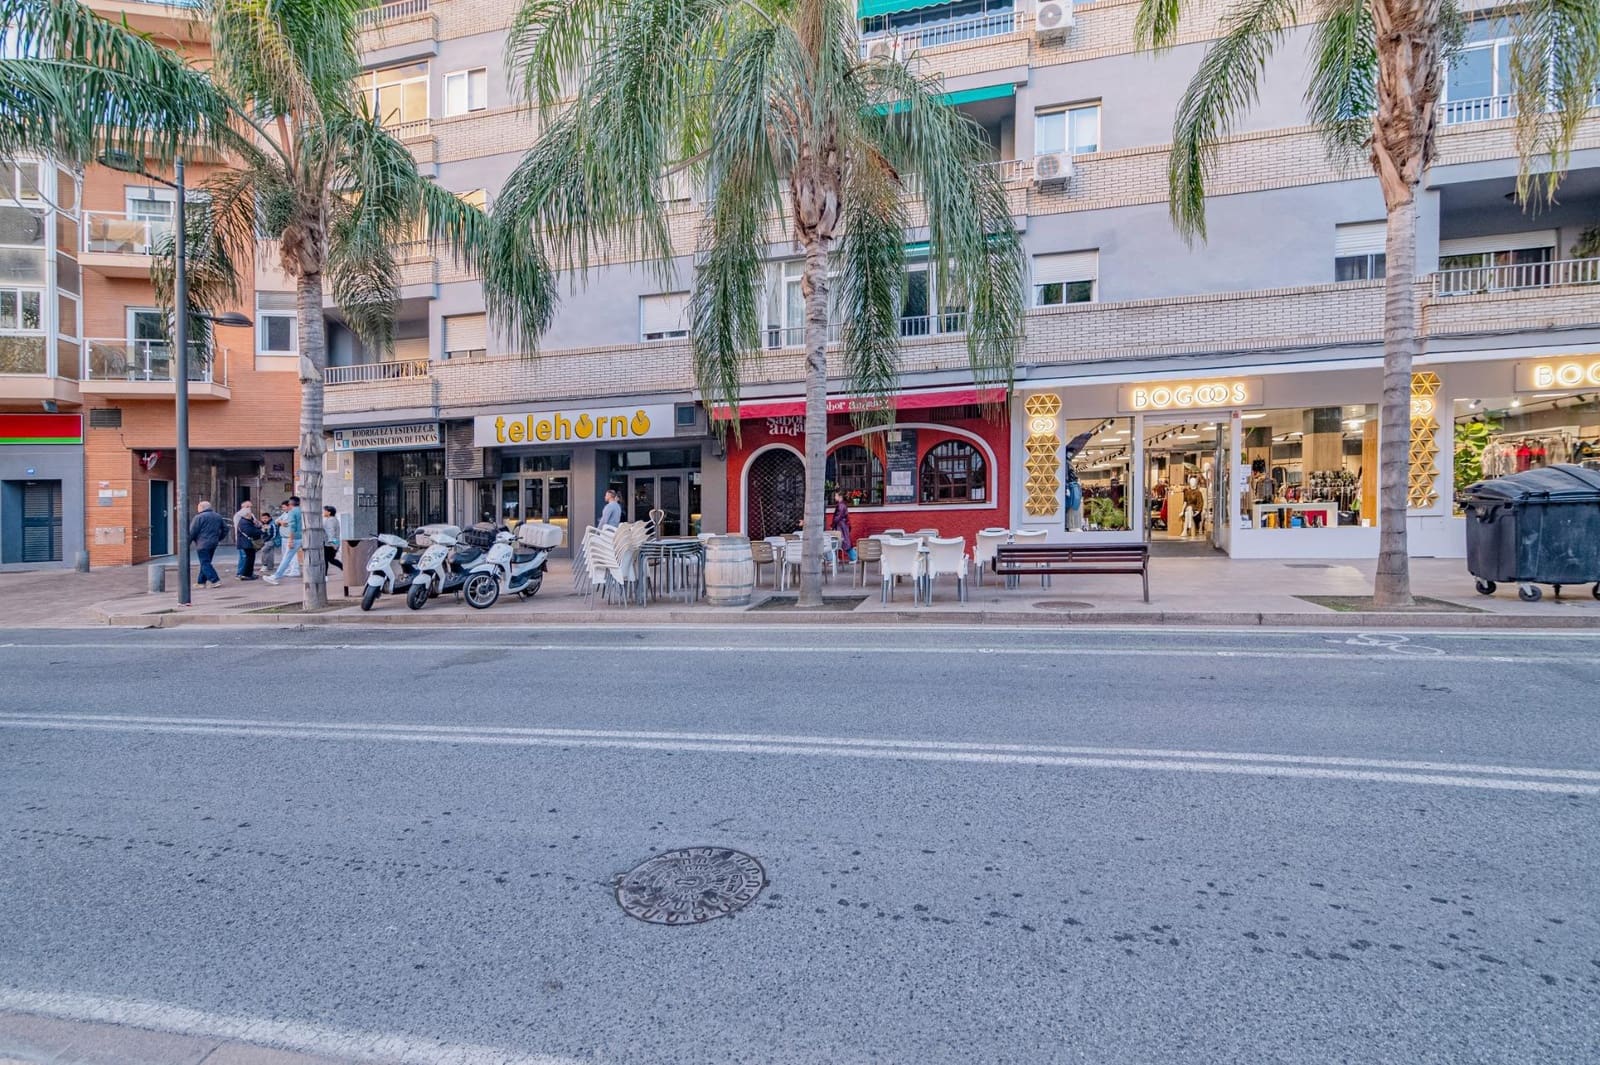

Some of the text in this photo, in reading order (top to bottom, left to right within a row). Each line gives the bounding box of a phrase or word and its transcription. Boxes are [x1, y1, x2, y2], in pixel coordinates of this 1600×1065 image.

[1135, 383, 1246, 407] BOGOOS
[352, 427, 387, 438] RODRIGUEZ
[394, 425, 422, 435] ESTEVEZ
[494, 410, 650, 443] telehorno
[769, 423, 806, 436] anda
[404, 435, 412, 444] DE
[415, 433, 438, 443] FINCAS
